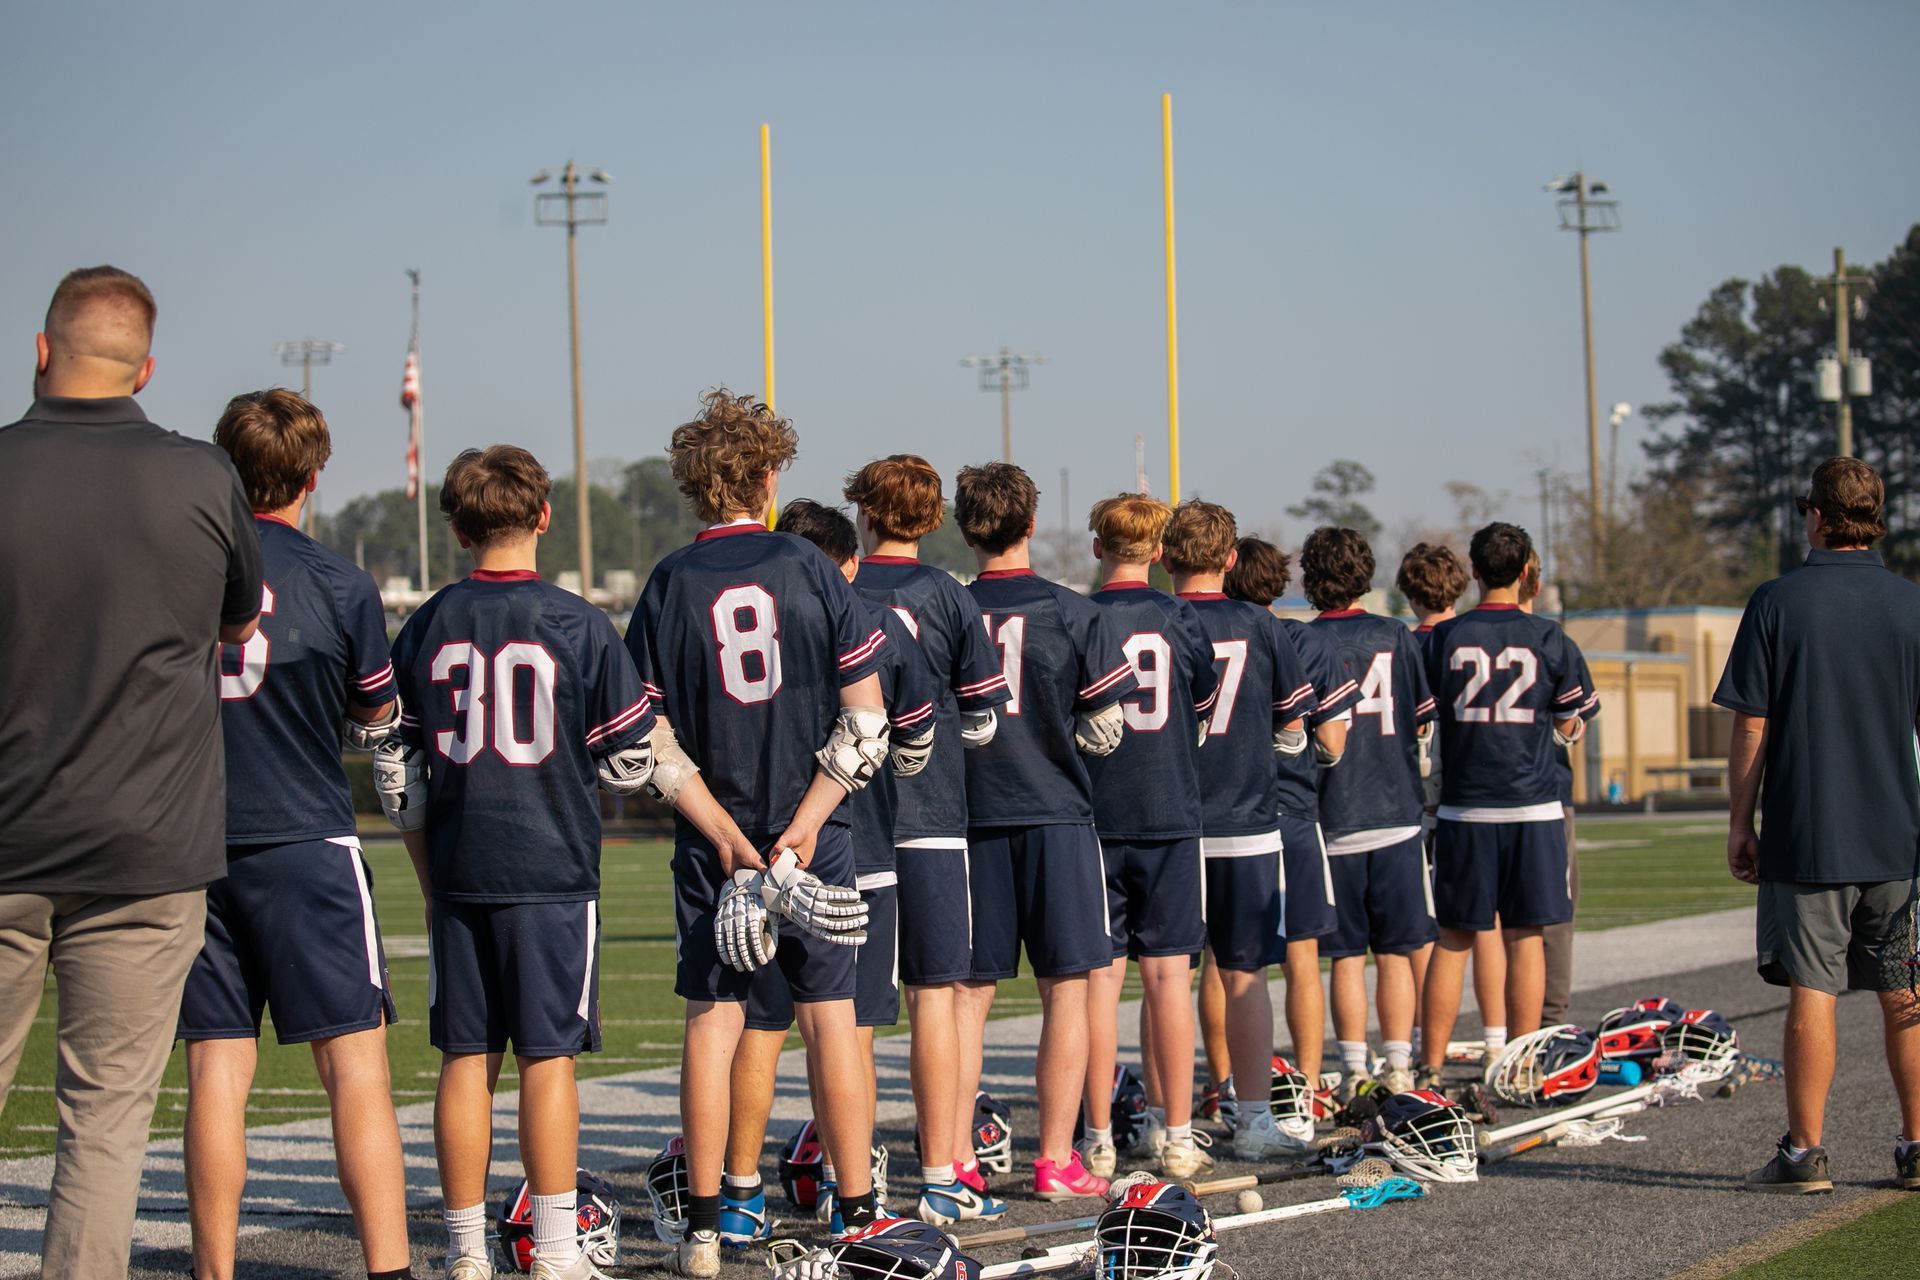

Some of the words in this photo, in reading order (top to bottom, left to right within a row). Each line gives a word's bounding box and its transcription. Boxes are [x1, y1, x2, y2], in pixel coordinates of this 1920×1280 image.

[709, 582, 782, 706] 8
[1120, 631, 1173, 733] 9
[1449, 645, 1538, 725] 22
[430, 640, 558, 766] 30
